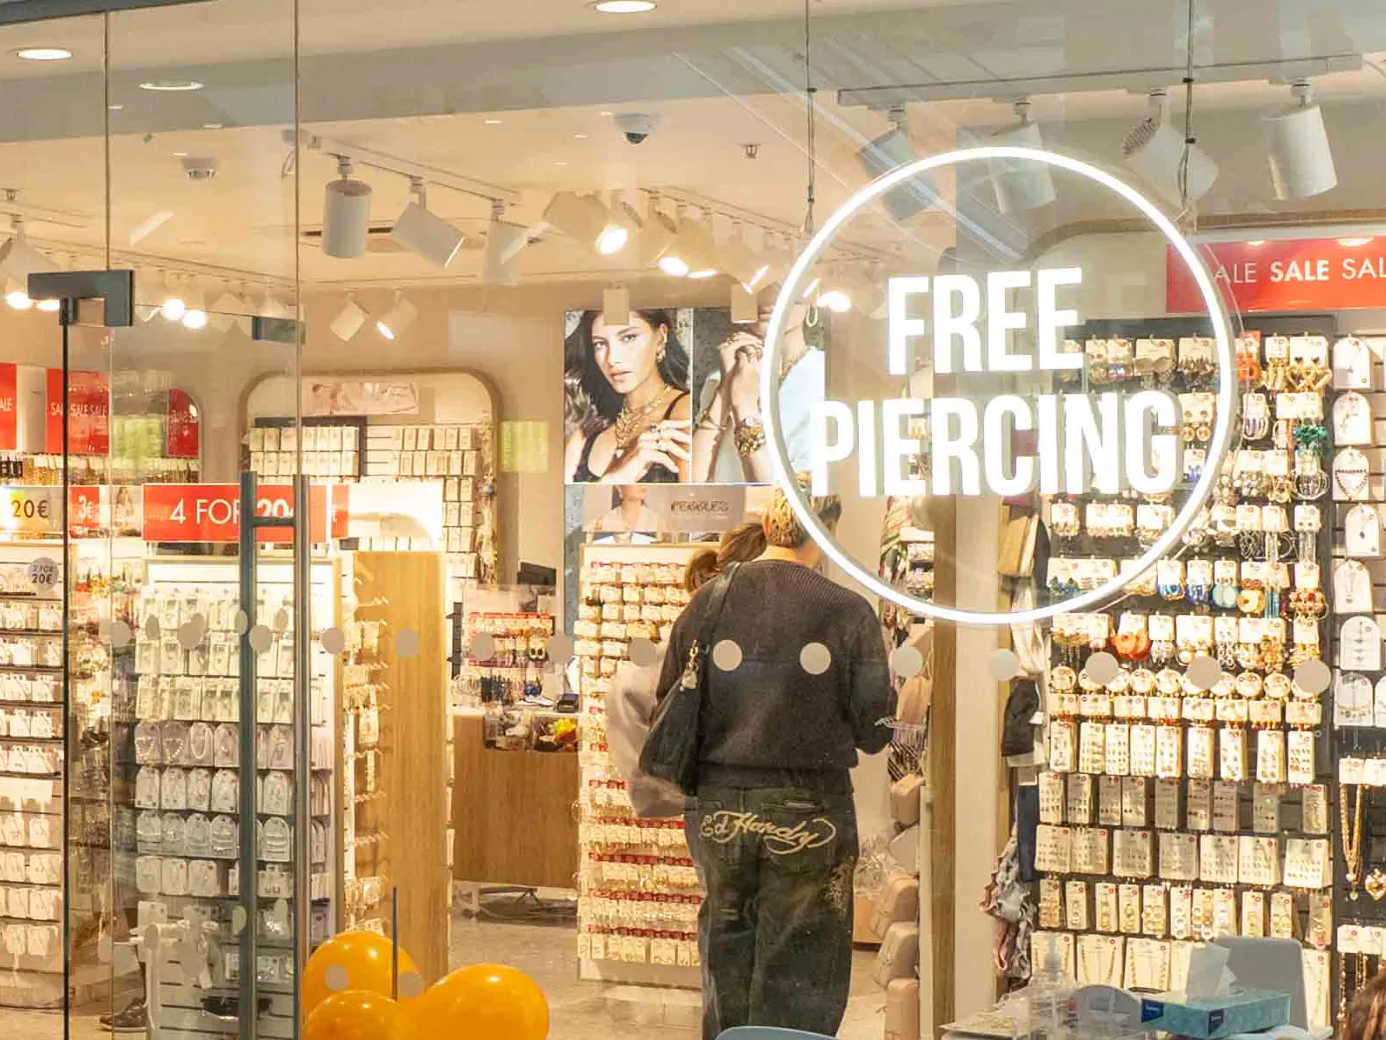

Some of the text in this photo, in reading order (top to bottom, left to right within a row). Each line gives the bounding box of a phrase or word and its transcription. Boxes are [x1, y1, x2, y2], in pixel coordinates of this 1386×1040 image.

[1214, 257, 1386, 285] ALE SALE SAL
[887, 267, 1086, 376] FREE
[51, 402, 63, 416] SA
[811, 391, 1182, 498] PIERCING
[12, 499, 49, 519] 20€
[169, 498, 186, 523] 4
[257, 499, 294, 518] 20
[31, 573, 53, 584] 20€
[699, 810, 836, 855] Ed Hardy
